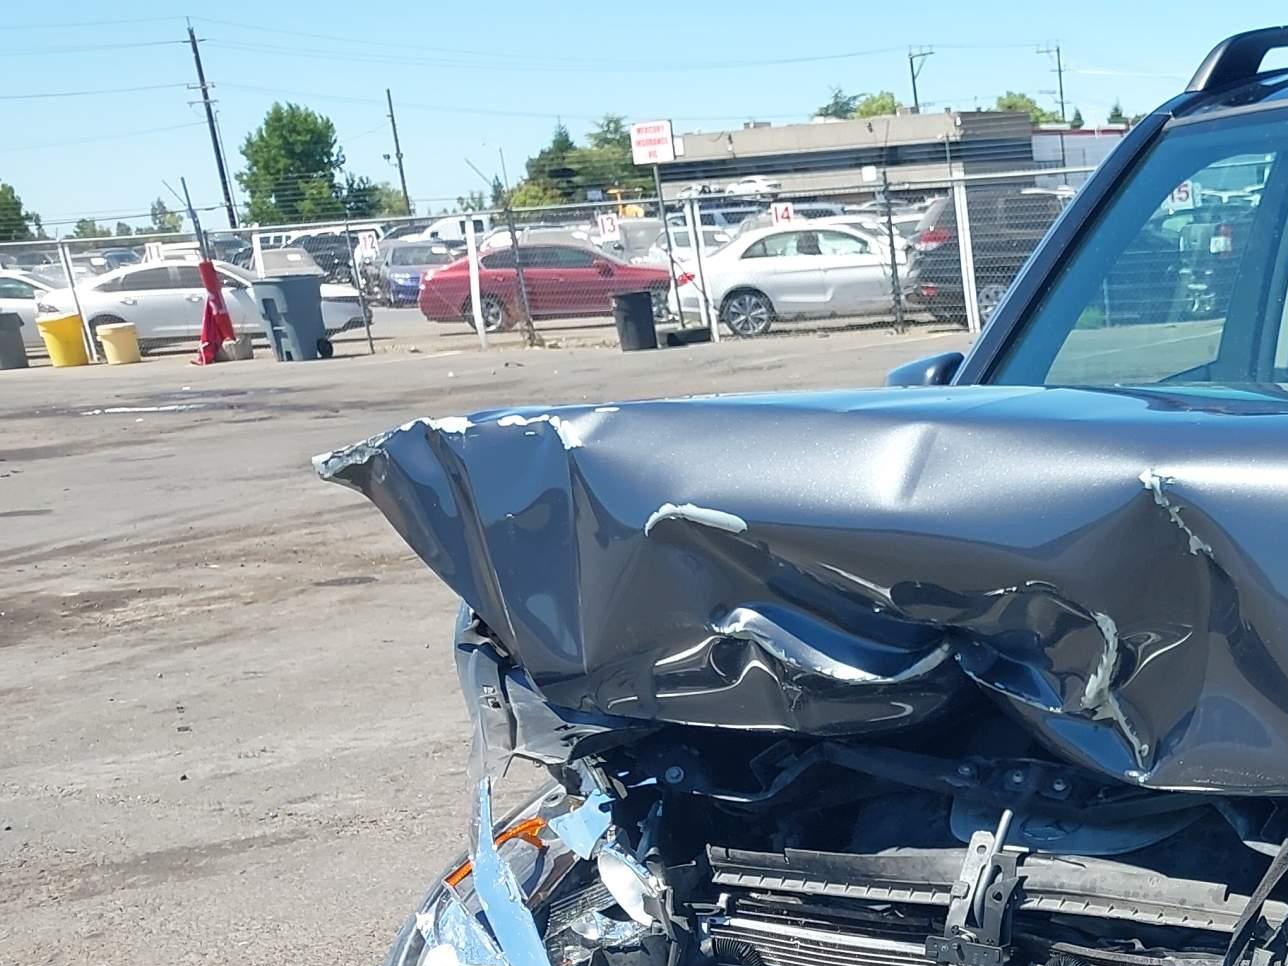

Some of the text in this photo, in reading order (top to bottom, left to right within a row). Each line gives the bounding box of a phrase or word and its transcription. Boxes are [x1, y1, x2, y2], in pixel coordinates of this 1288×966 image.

[774, 206, 791, 223] 14
[600, 216, 616, 234] 13
[363, 234, 376, 250] 12
